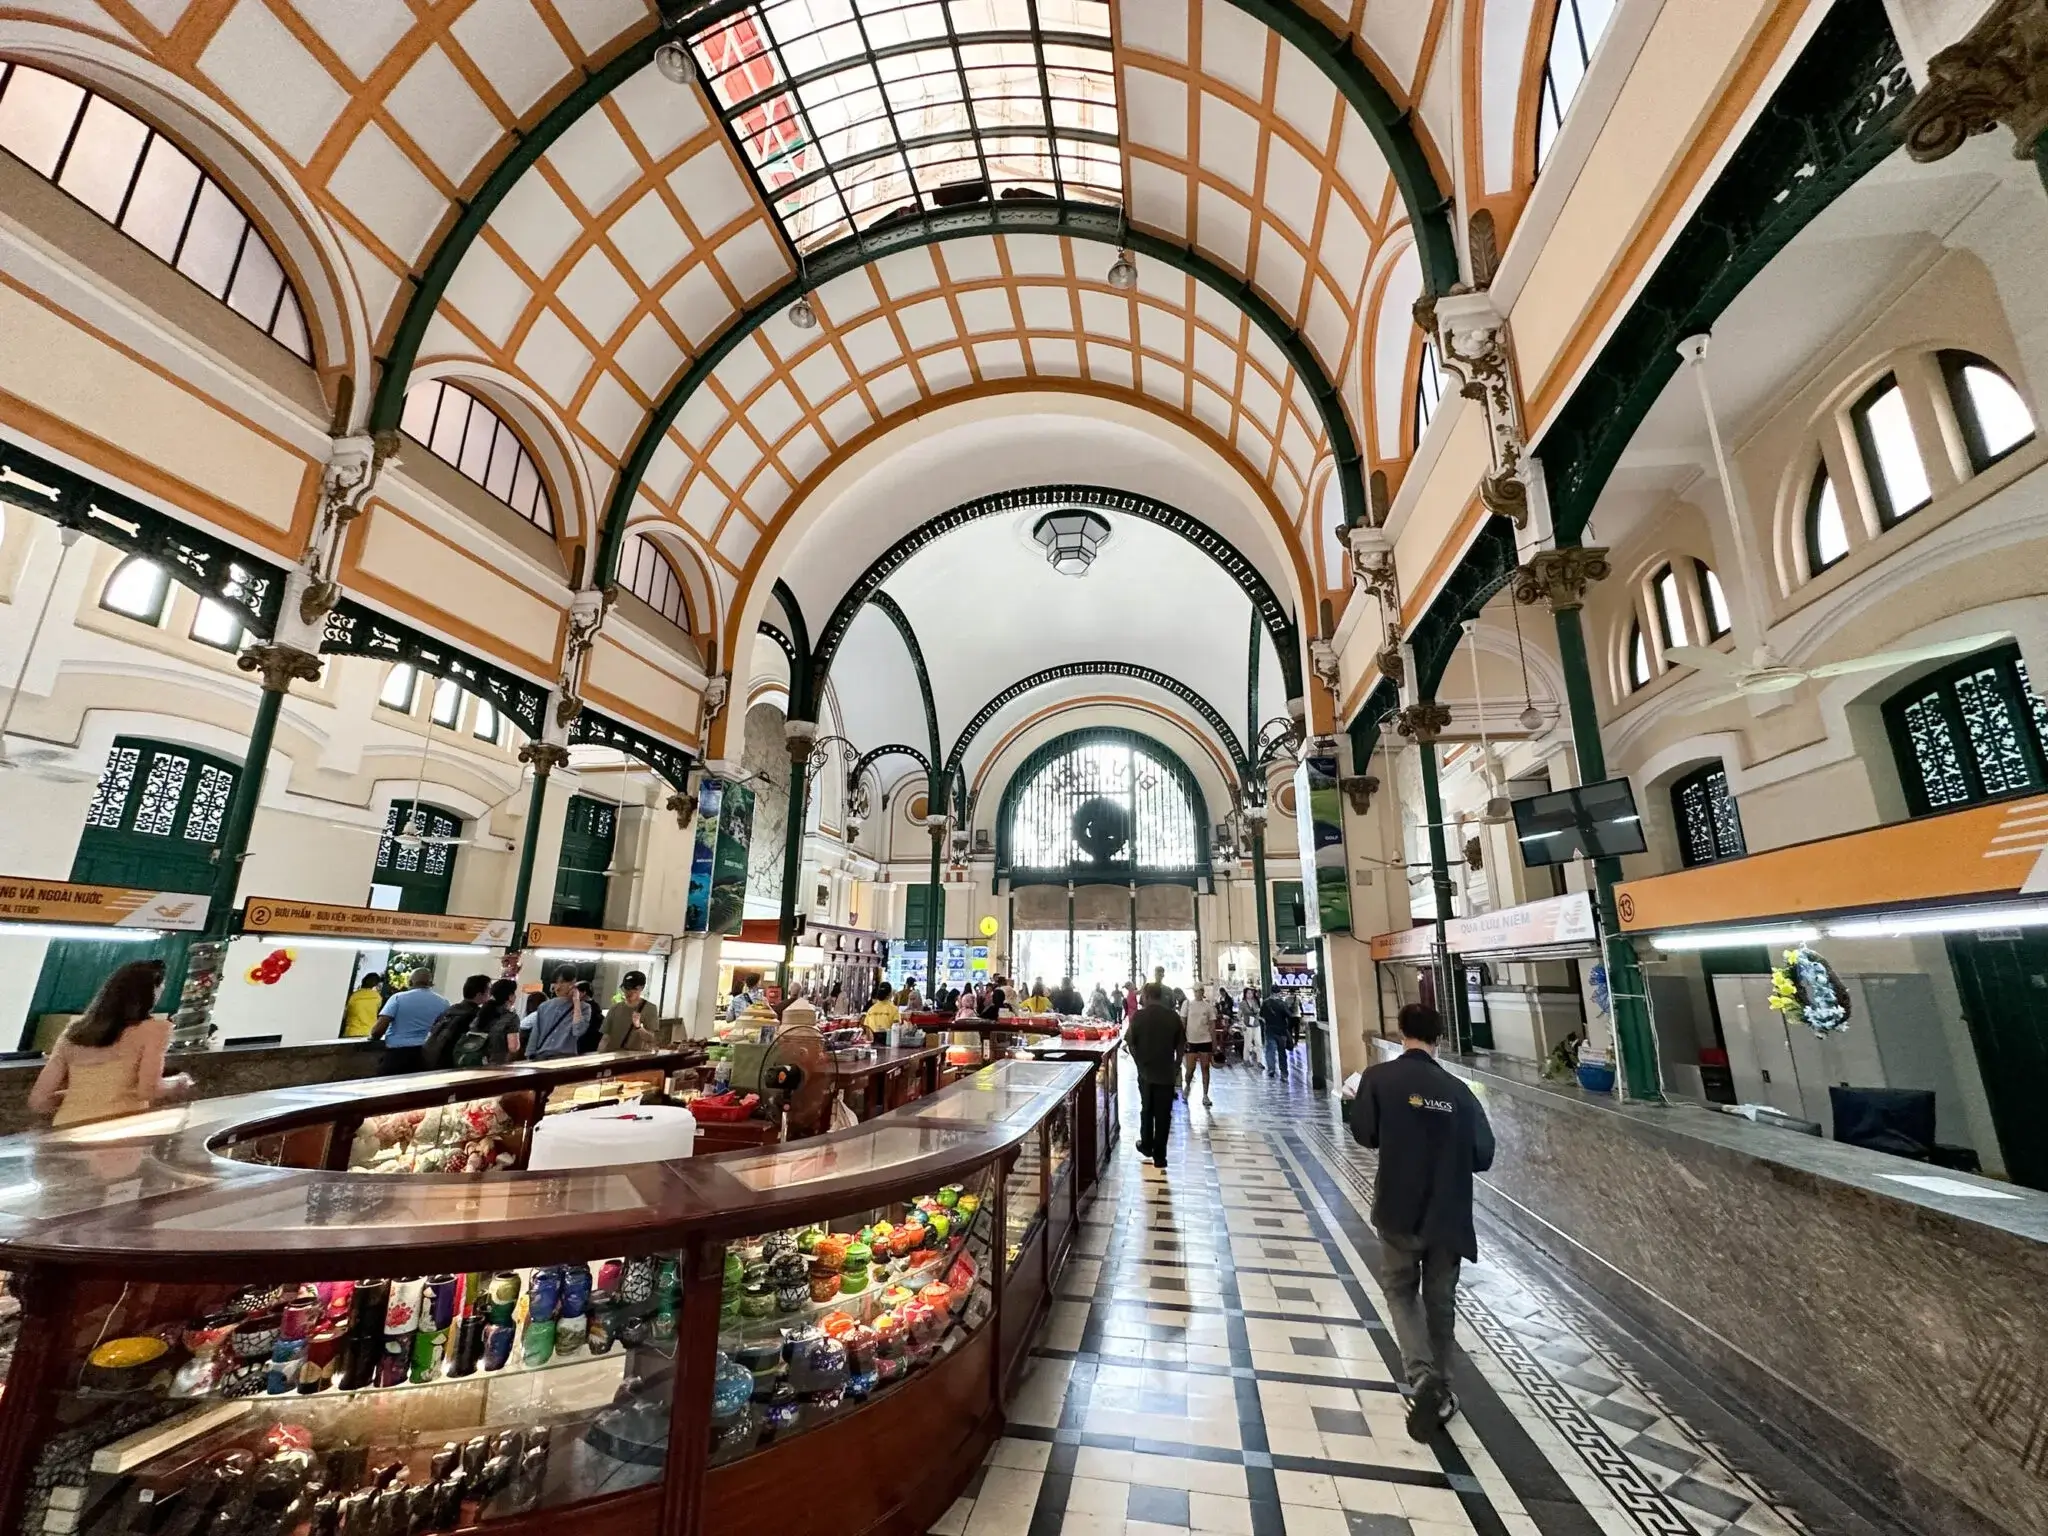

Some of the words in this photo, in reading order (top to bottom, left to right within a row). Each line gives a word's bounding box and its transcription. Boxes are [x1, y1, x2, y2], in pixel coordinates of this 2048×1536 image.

[37, 887, 72, 902] NGOÀI
[1620, 899, 1632, 917] 13
[255, 910, 265, 922] 2
[1424, 1098, 1453, 1110] VIAGS
